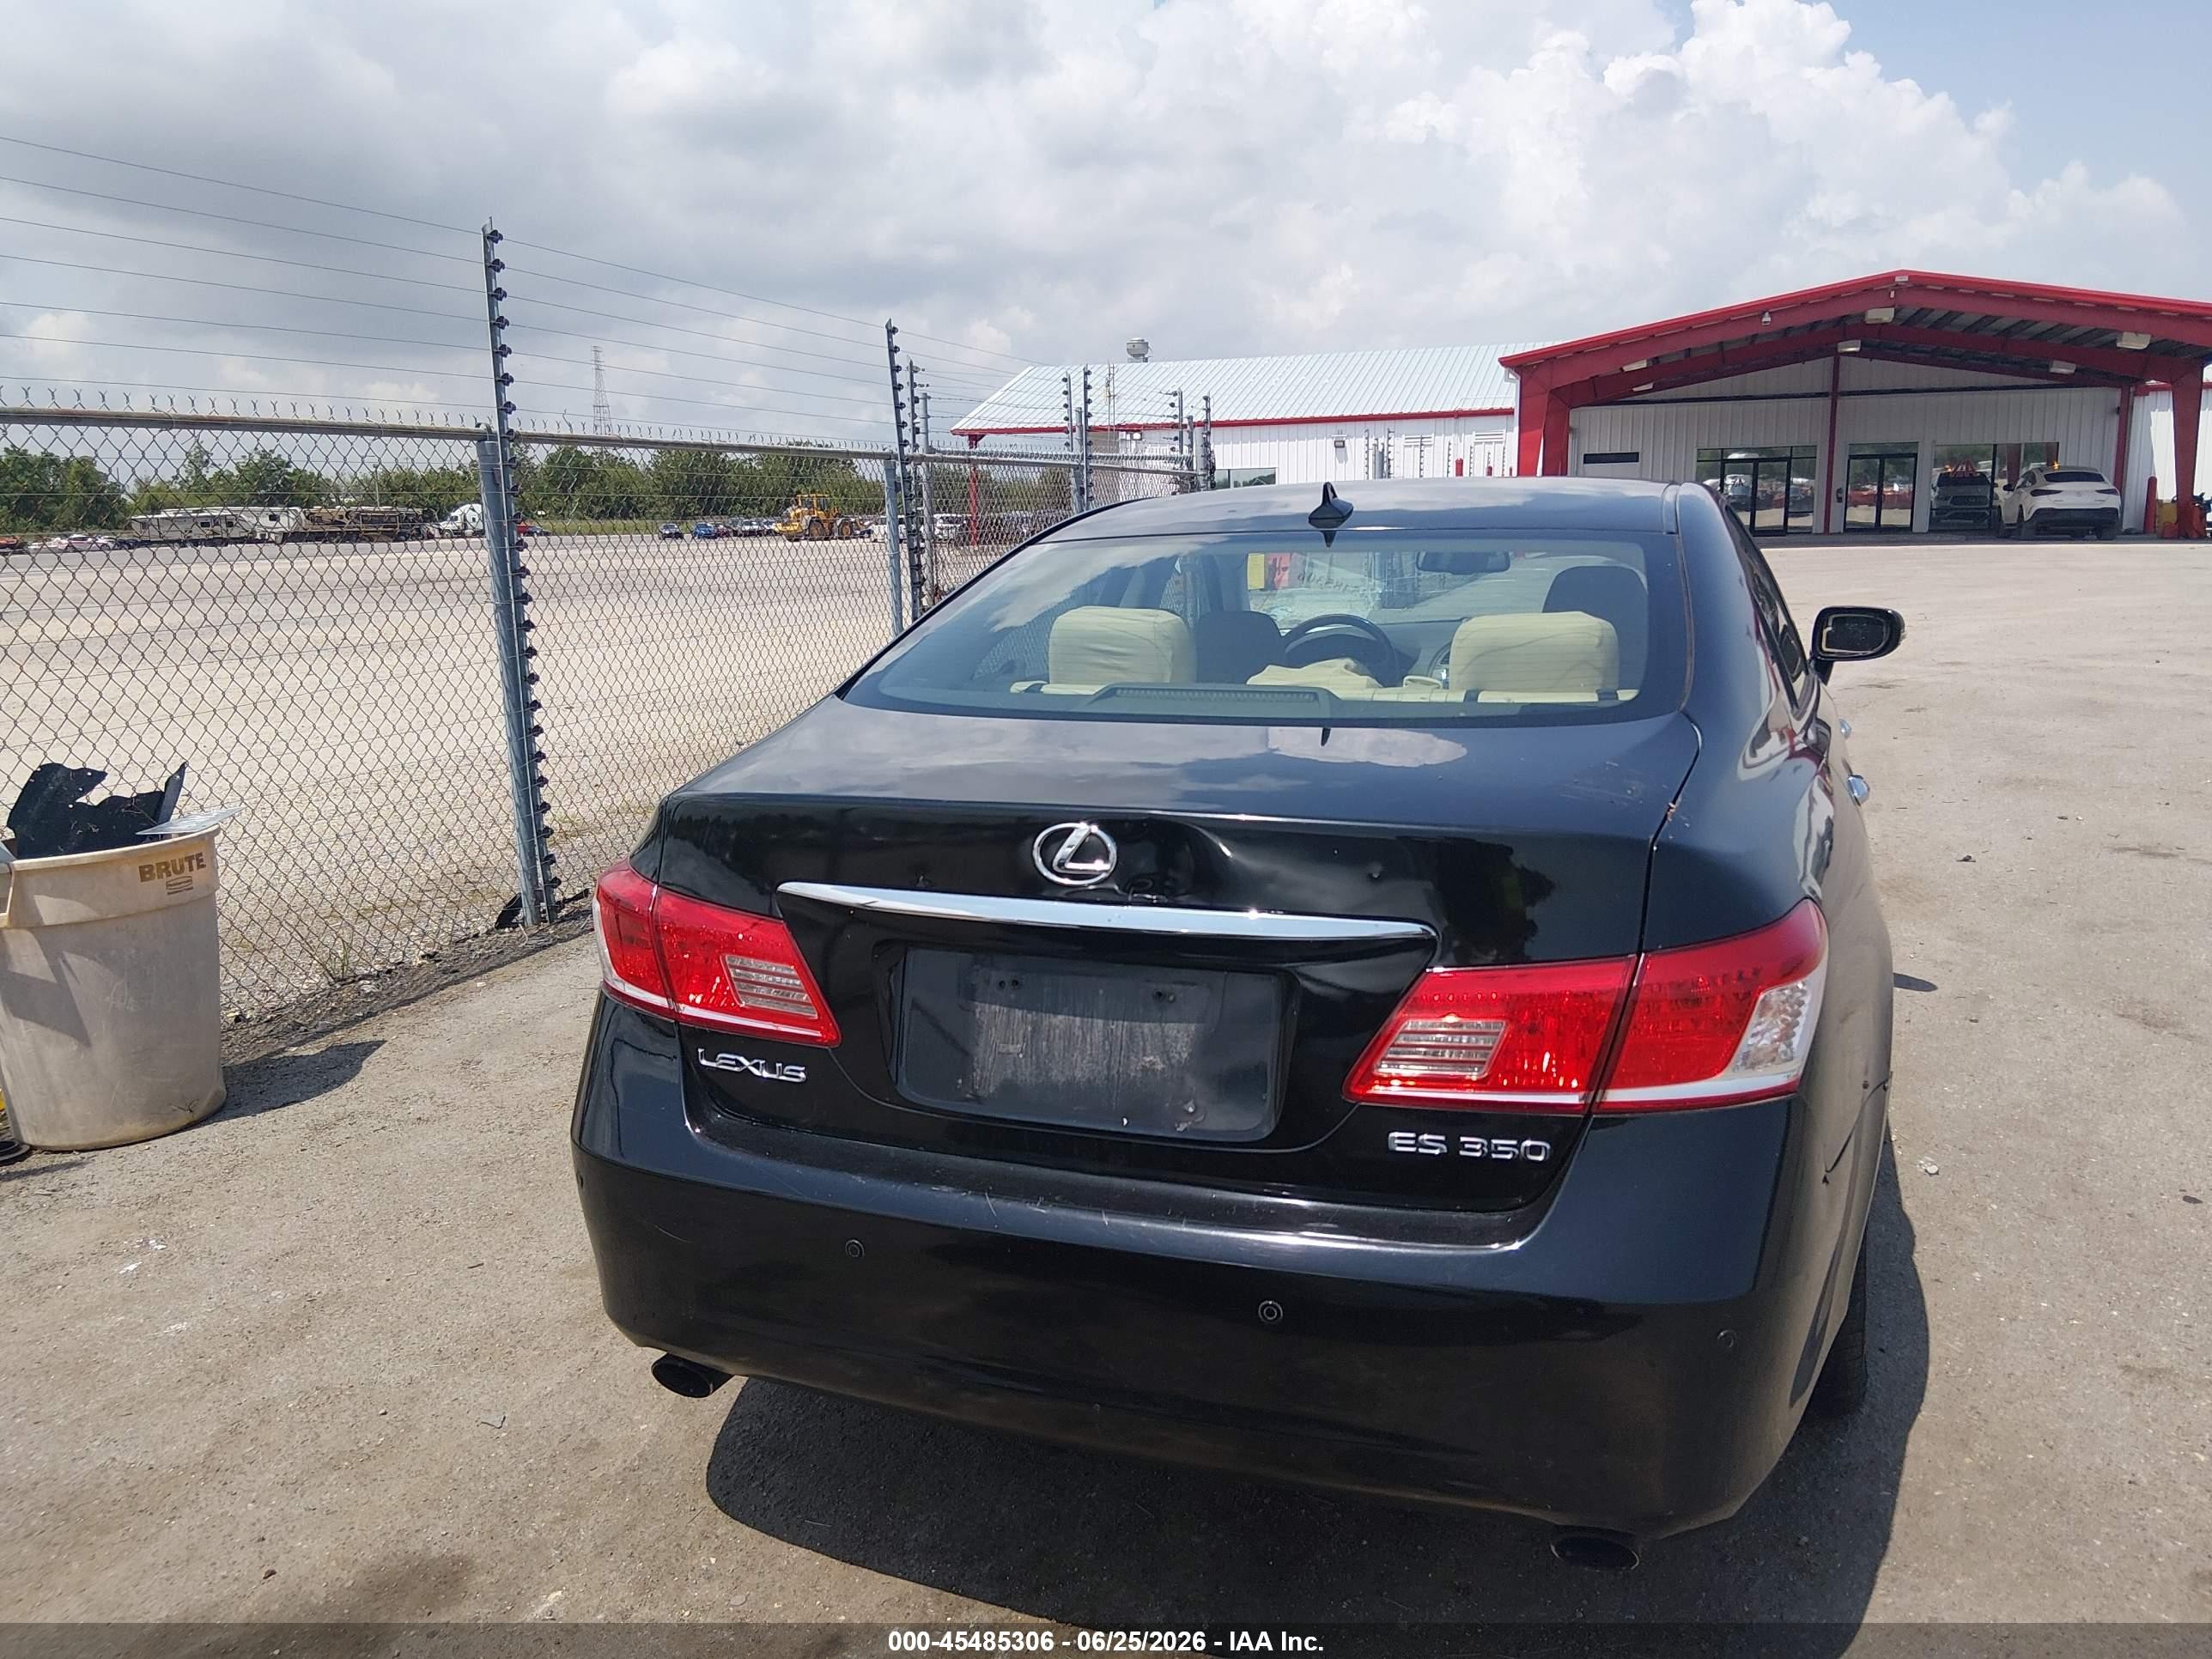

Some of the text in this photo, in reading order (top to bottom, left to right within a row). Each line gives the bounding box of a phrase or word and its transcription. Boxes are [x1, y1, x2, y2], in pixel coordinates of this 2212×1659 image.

[138, 852, 207, 883] BRUTE
[697, 1048, 806, 1083] LEXUS
[1388, 1131, 1552, 1162] ES 350
